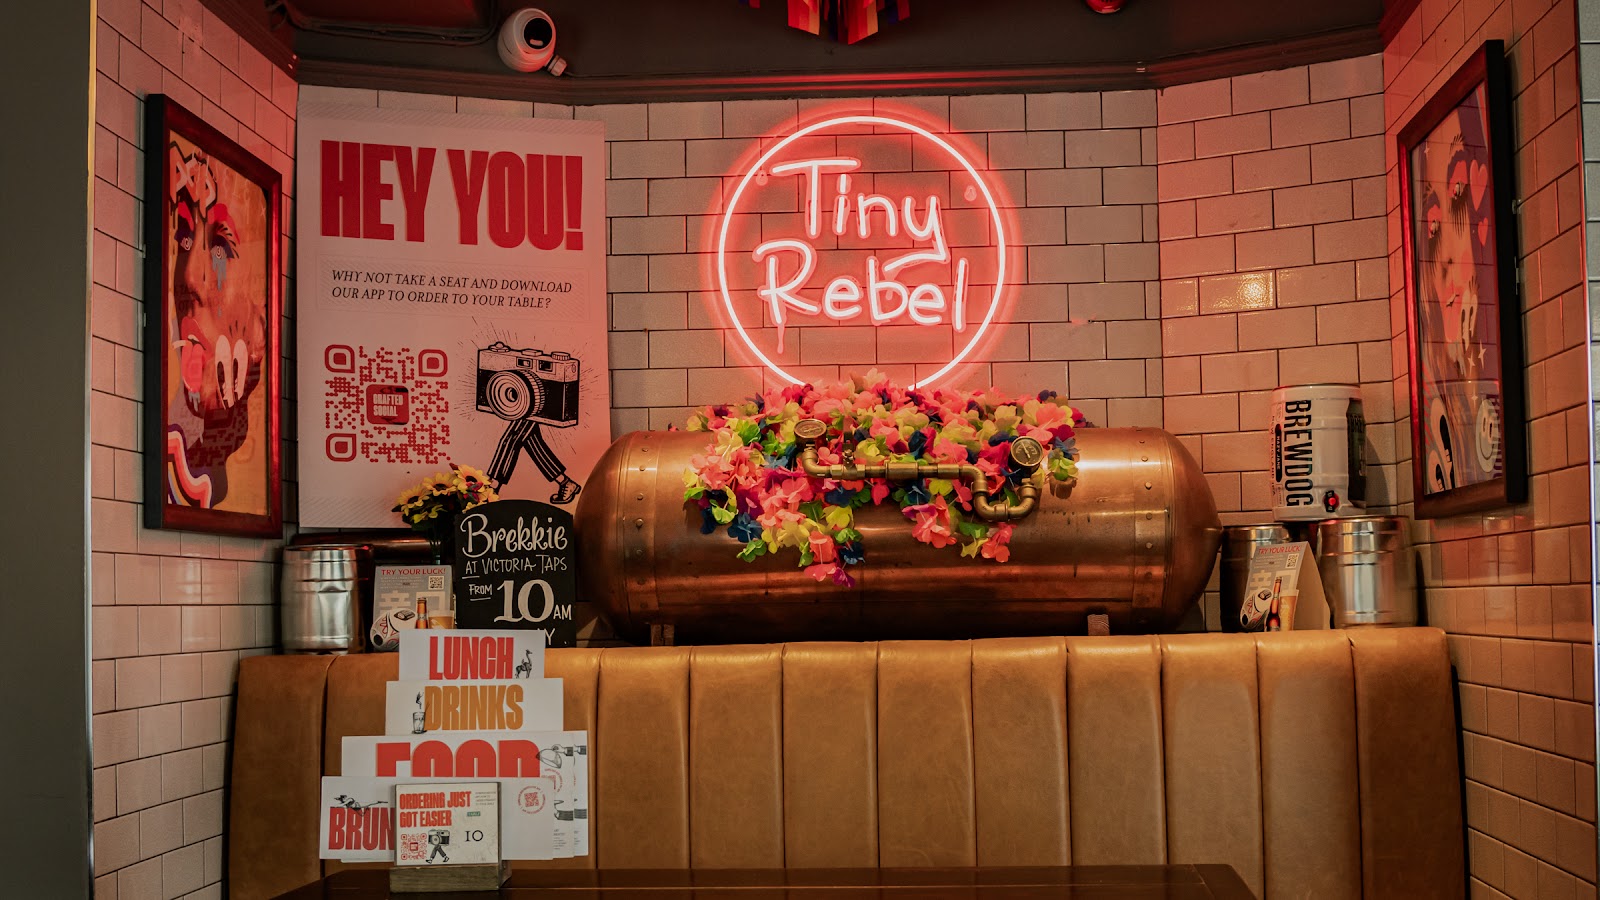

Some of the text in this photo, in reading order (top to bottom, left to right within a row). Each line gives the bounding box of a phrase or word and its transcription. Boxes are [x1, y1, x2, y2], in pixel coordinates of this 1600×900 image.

[321, 140, 583, 251] HEY YOU!
[771, 158, 947, 272] Tiny
[332, 270, 572, 293] WHY NOT TAKE A SEAT AND DOWNLOAD
[755, 240, 967, 331] Rebel
[332, 287, 552, 309] OUR APP TO ORDER TO YOUR TABLE?
[373, 393, 404, 406] CRAFTED
[373, 405, 399, 417] SOCIAL
[1284, 399, 1314, 507] BREWDOG
[460, 513, 568, 558] Brekkie
[422, 567, 446, 575] LUCK!
[465, 554, 567, 574] AT VICTORIA TAPS
[469, 583, 493, 596] FROM
[429, 636, 514, 681] LUNCH
[424, 684, 524, 731] DRINKS
[399, 792, 445, 809] ORDERING
[447, 791, 471, 808] JUST
[328, 807, 395, 850] BRUN
[399, 810, 452, 828] GOT EASIER
